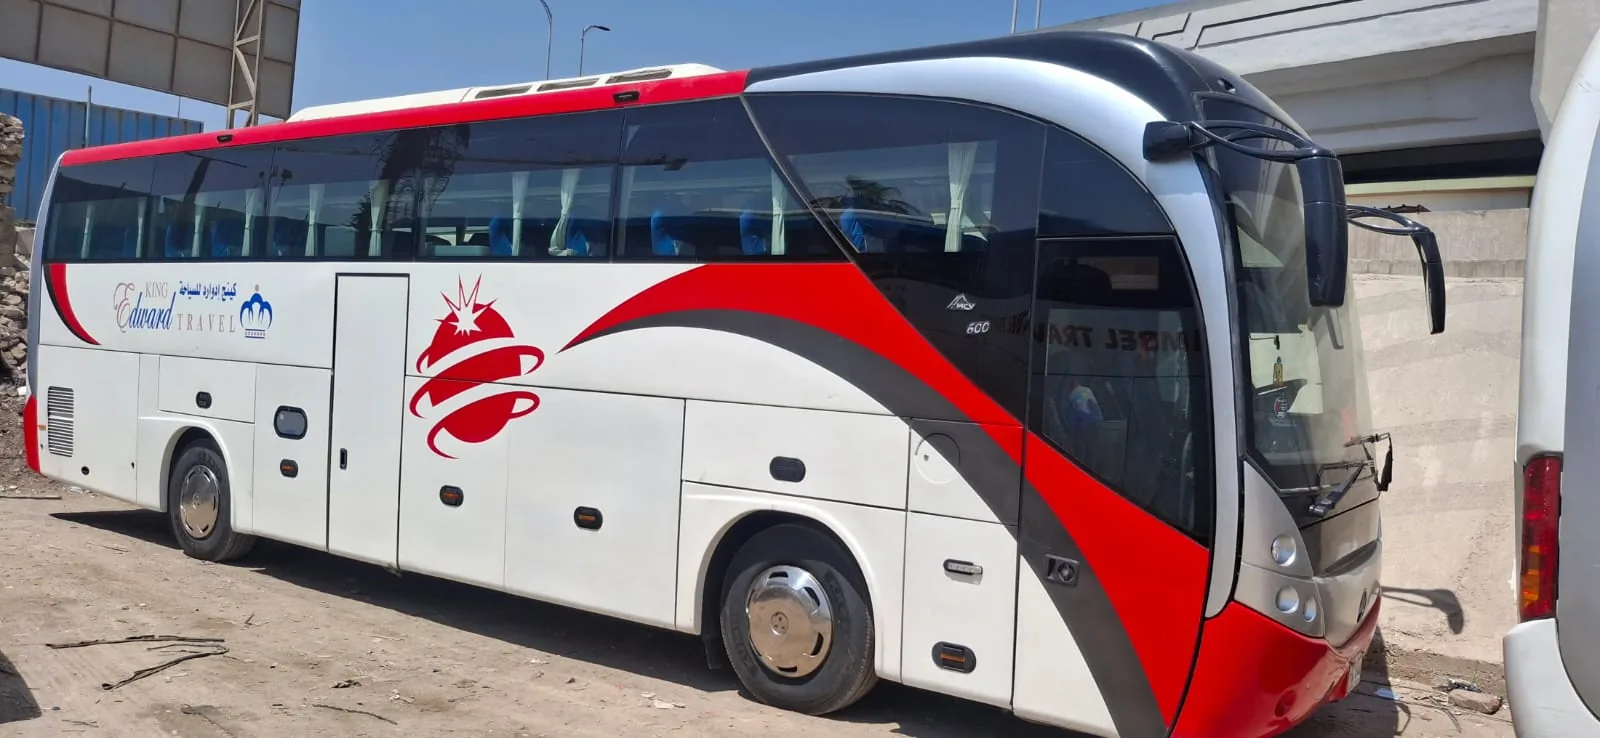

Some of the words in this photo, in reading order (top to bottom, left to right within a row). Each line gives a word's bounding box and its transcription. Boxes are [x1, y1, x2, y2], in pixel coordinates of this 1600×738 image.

[144, 281, 168, 299] KING
[179, 280, 202, 300] للسياحة
[221, 281, 237, 302] كينج
[113, 282, 177, 333] Edward
[176, 313, 236, 334] TRAVEL
[966, 320, 990, 335] 600
